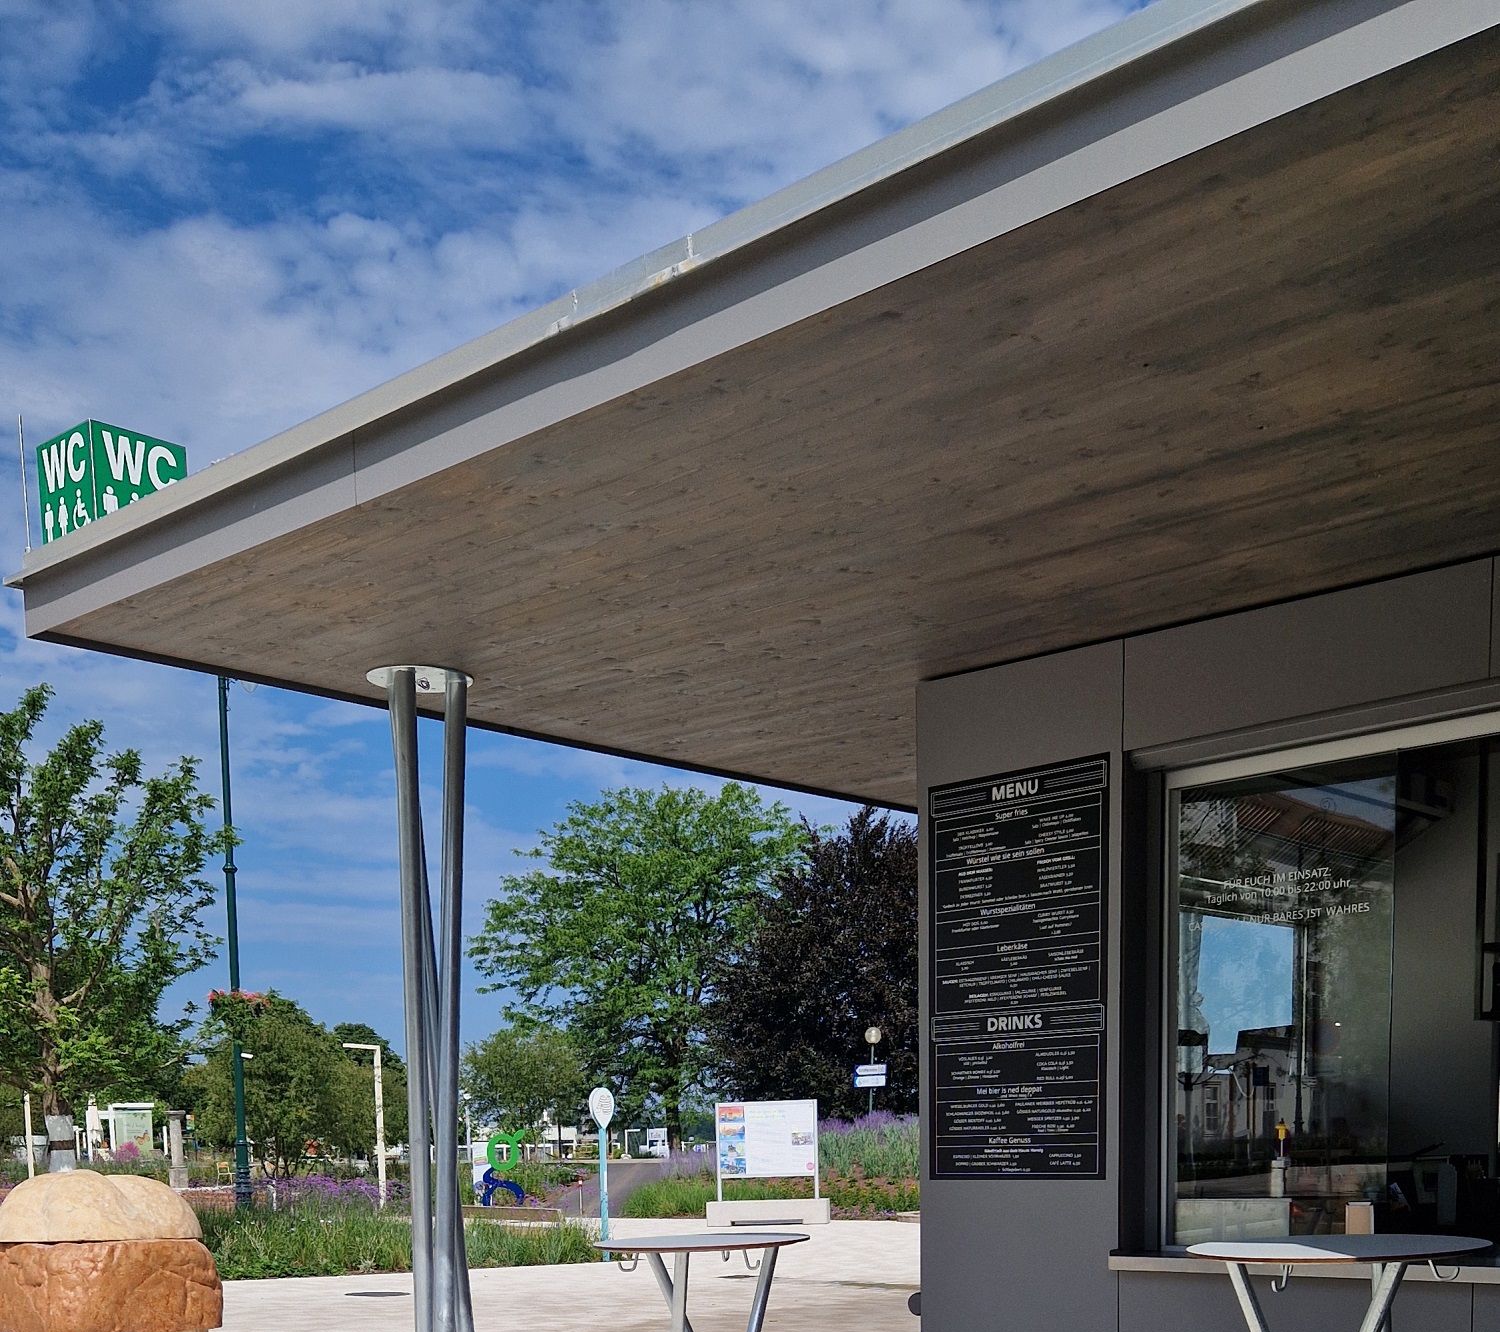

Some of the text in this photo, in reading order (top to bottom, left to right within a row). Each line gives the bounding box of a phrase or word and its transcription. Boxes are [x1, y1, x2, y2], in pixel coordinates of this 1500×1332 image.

[42, 431, 86, 494] WC
[101, 430, 178, 490] WC
[991, 778, 1039, 801] MENU
[995, 808, 1028, 820] Super fries
[966, 855, 990, 866] Würstel
[990, 854, 1000, 862] wie
[1002, 852, 1011, 860] sie
[1012, 850, 1025, 858] sein
[1026, 848, 1045, 856] sollen
[1244, 875, 1270, 887] EUCH
[1272, 874, 1286, 884] IM
[1288, 867, 1332, 882] EINSATZ:
[1240, 890, 1258, 900] von
[1260, 886, 1285, 899] 10:00
[1288, 884, 1302, 894] bis
[1304, 880, 1331, 892] 22:00
[1332, 879, 1351, 889] uhr
[980, 903, 1036, 916] Wurstspezialitäten
[1250, 913, 1270, 924] NUR
[1272, 910, 1304, 922] BARES
[1306, 908, 1322, 918] IST
[1326, 902, 1370, 916] WAHRES
[996, 942, 1028, 952] Leberkäse
[987, 1014, 1042, 1032] DRINKS
[992, 1042, 1025, 1050] Alkoholfrei
[988, 1086, 1000, 1094] bier
[1002, 1086, 1007, 1094] is
[1008, 1086, 1020, 1094] ned
[1020, 1086, 1042, 1095] deppat
[988, 1136, 1032, 1144] Kaffee Genuss
